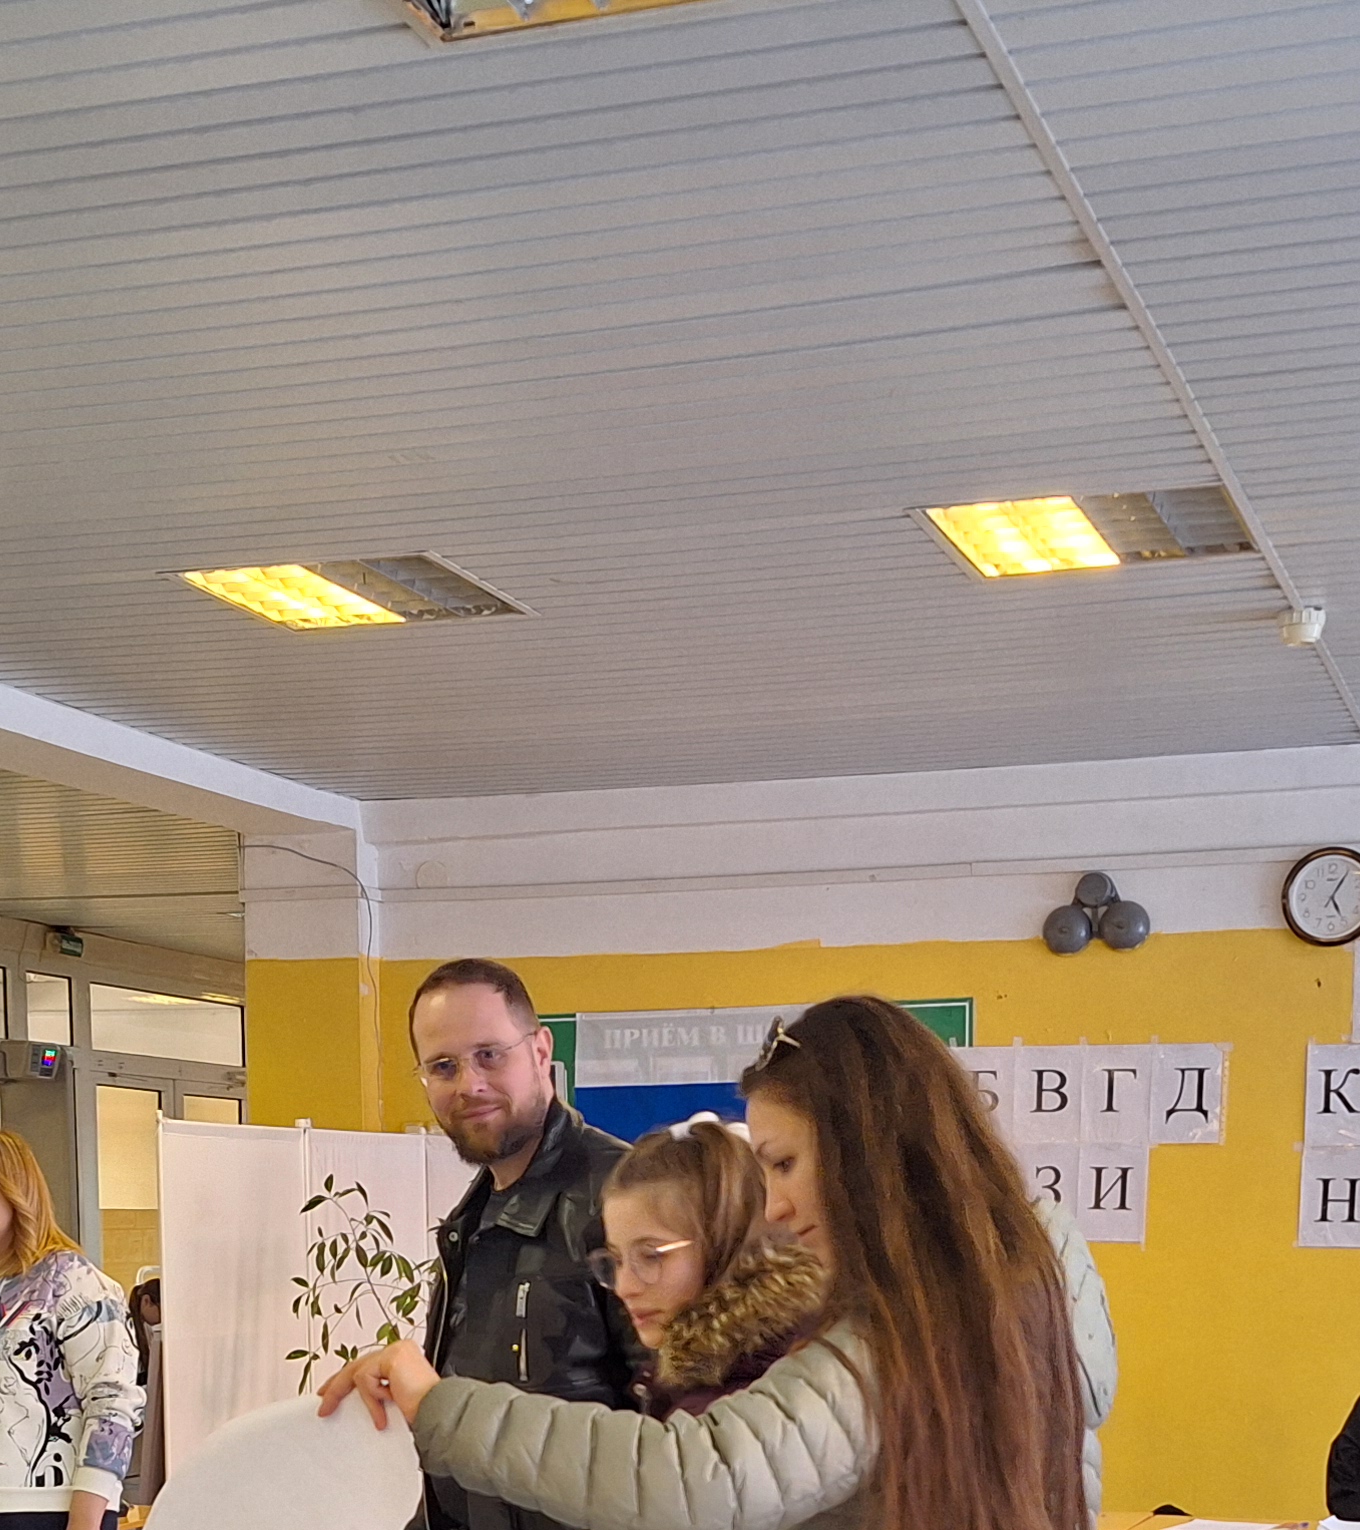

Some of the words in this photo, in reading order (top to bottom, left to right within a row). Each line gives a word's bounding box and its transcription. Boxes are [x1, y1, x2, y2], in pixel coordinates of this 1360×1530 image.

[604, 1023, 700, 1048] ПРИЁМ
[711, 1027, 726, 1043] В
[1033, 1070, 1068, 1112] В
[1102, 1069, 1136, 1112] Г
[1166, 1068, 1208, 1122] Д
[1320, 1069, 1360, 1113] К
[1091, 1167, 1132, 1210] И
[1318, 1179, 1360, 1222] Н
